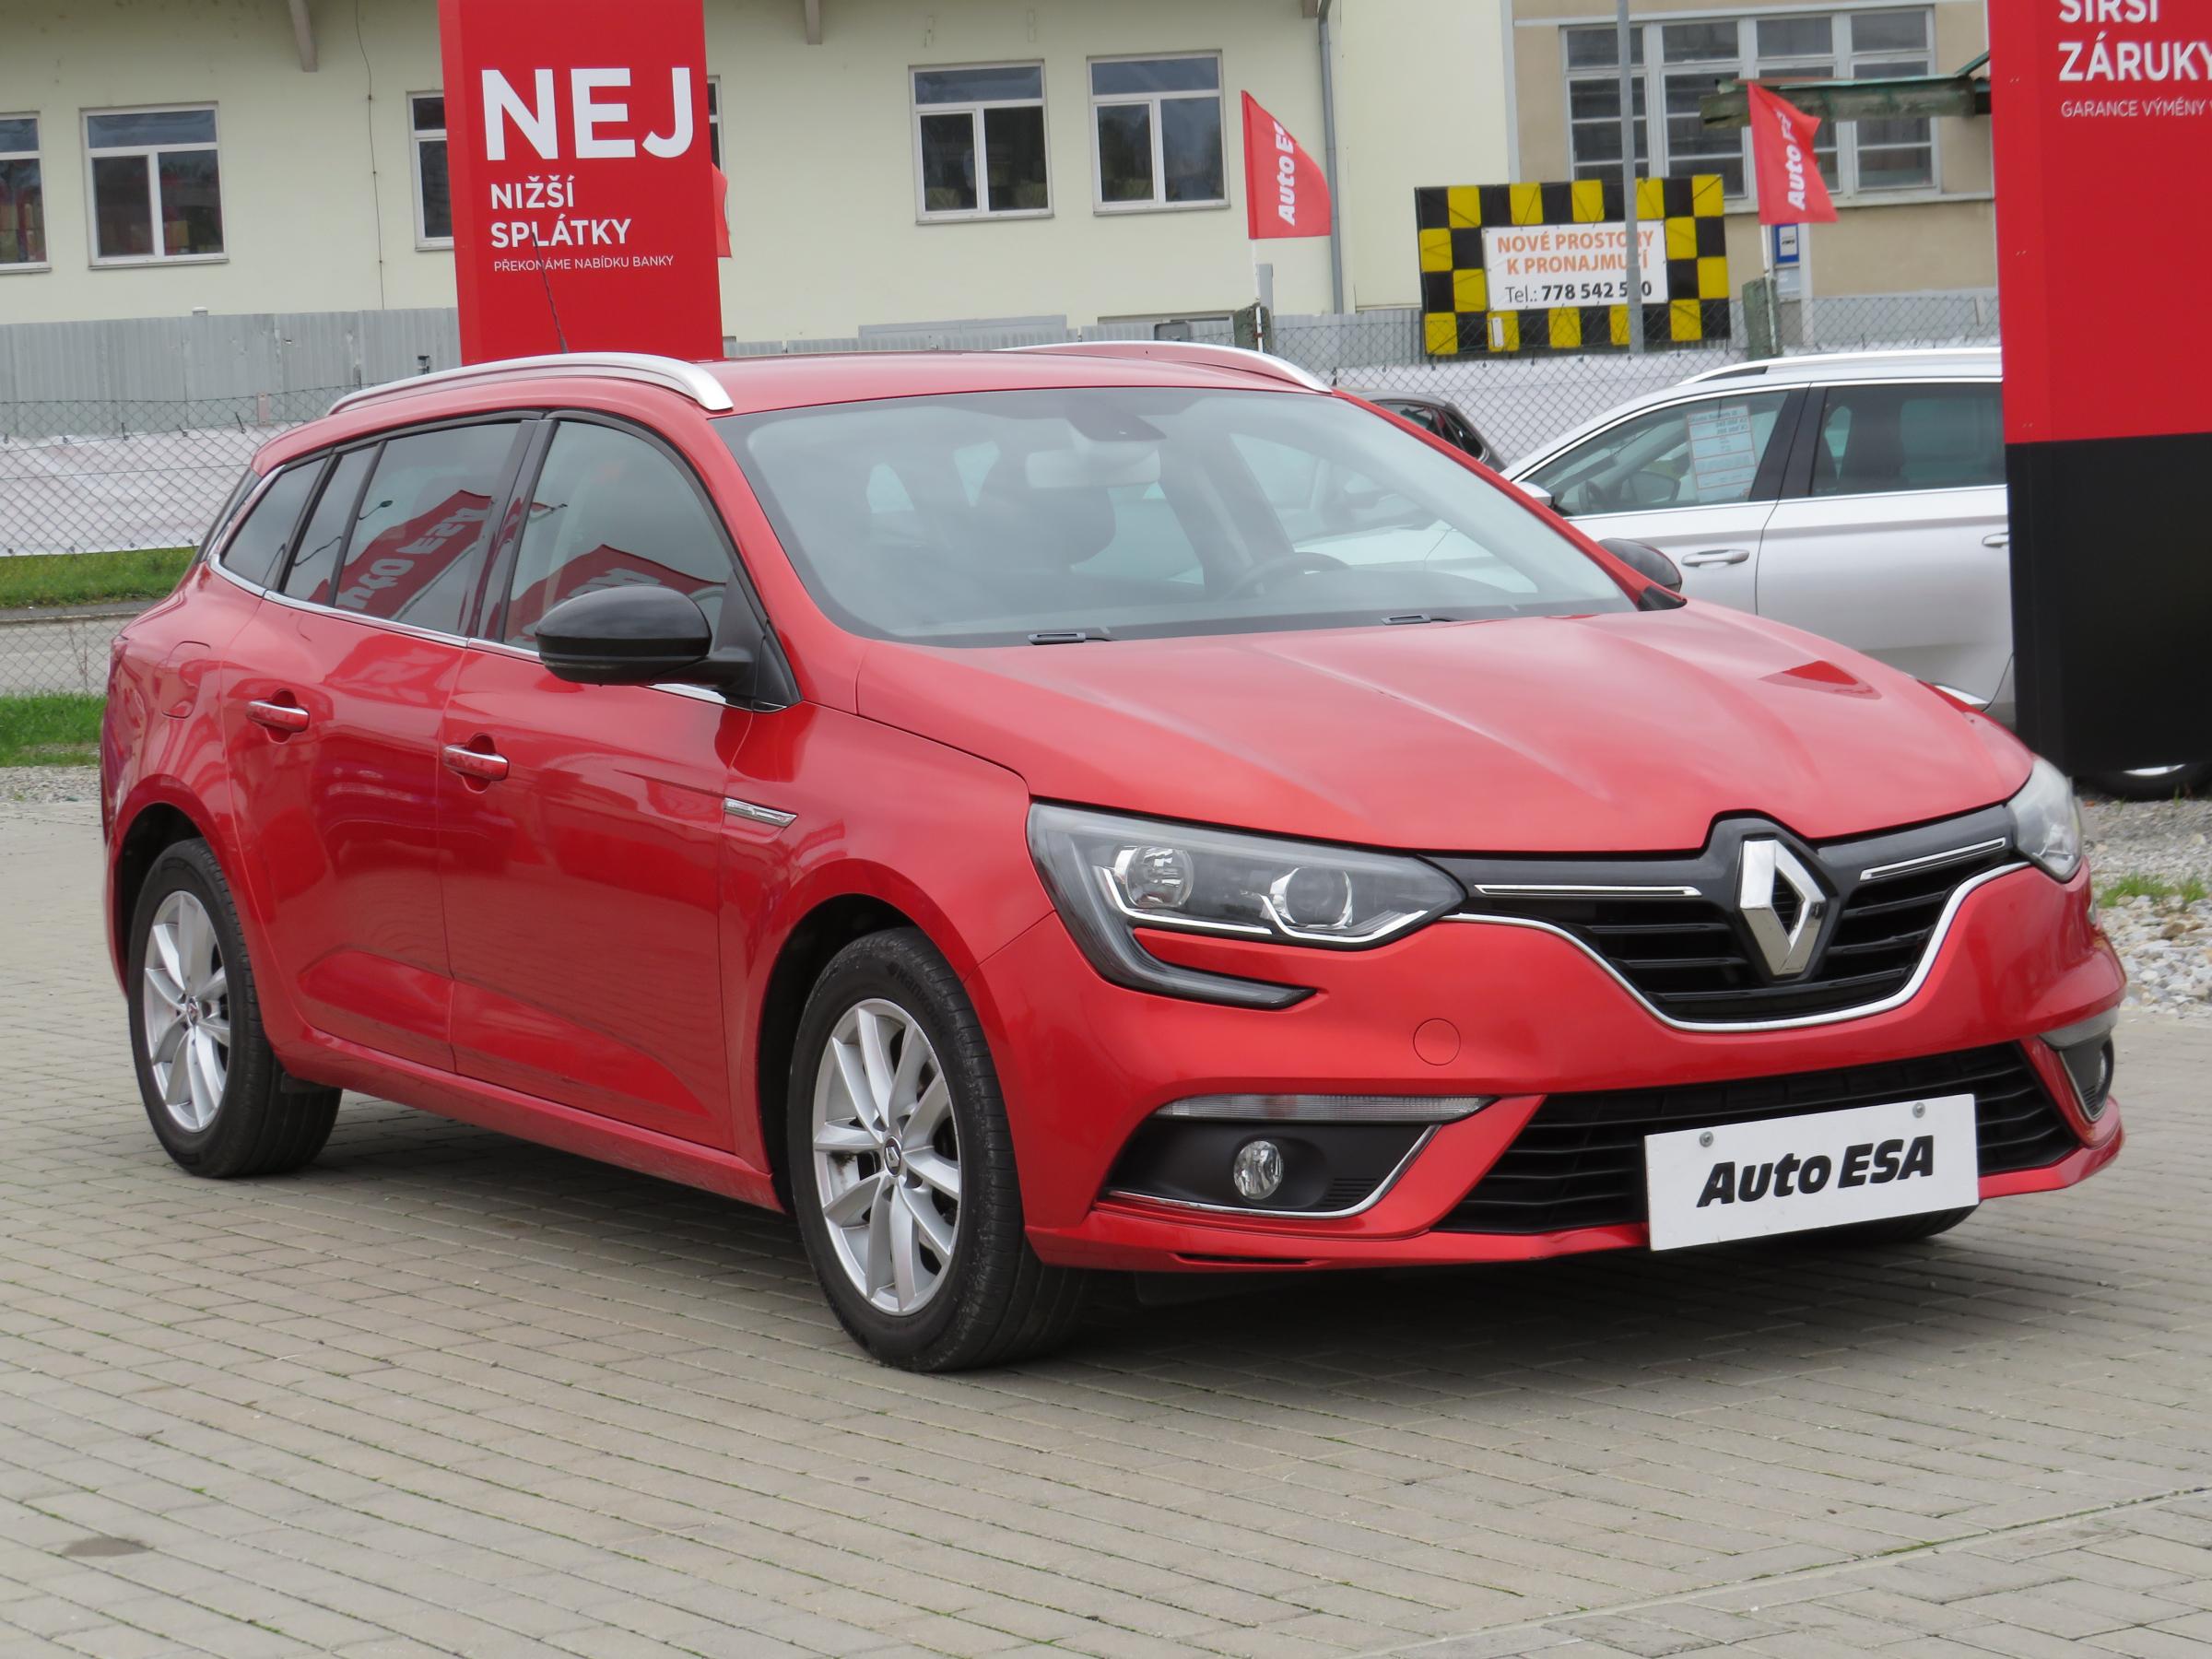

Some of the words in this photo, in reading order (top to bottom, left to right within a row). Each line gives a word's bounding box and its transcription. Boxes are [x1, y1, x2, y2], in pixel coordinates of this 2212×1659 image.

[2058, 30, 2212, 82] ZÁRUKY
[481, 67, 694, 161] NEJ
[2061, 100, 2138, 118] GARANCE
[490, 174, 575, 209] NIŽŠÍ
[1277, 155, 1296, 227] Auto
[1785, 144, 1806, 211] Auto
[490, 213, 632, 249] SPLÁTKY
[1497, 230, 1551, 253] NOVÉ
[494, 257, 571, 273] PŘEKONÁME
[574, 254, 629, 270] NABÍDKU
[632, 254, 674, 268] BANKY
[1507, 258, 1520, 275] K
[1524, 250, 1649, 274] PRONAJMUÍ
[1505, 286, 1538, 303] Tel.:
[1541, 283, 1576, 301] 778
[1580, 281, 1614, 299] 542
[1618, 280, 1653, 298] 50
[1696, 1152, 1832, 1208] Auto
[1837, 1134, 1935, 1189] ESA
